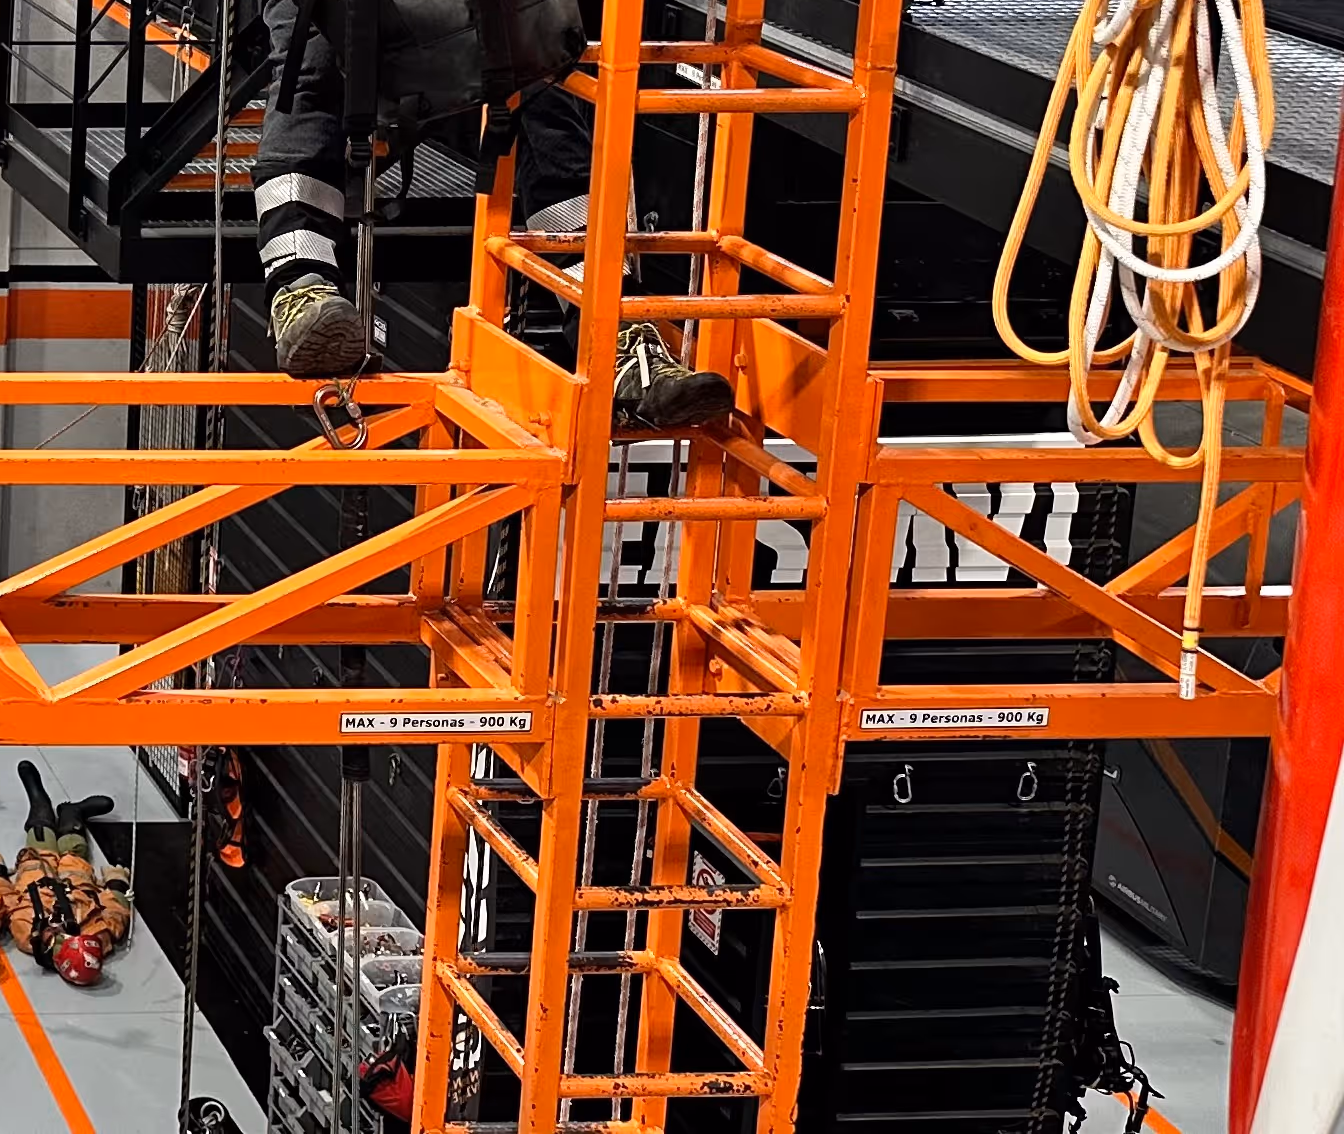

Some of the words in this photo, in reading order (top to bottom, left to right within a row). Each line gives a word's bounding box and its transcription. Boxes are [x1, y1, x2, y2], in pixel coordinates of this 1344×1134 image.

[345, 717, 375, 728] MAX
[389, 717, 398, 728] 9
[403, 717, 465, 728] Personas
[479, 716, 505, 727] 900
[509, 716, 527, 729] Kg
[866, 713, 895, 724] MAX
[909, 713, 918, 724] 9
[922, 712, 984, 724] Personas
[997, 712, 1023, 723] 900
[1027, 711, 1044, 725] Kg
